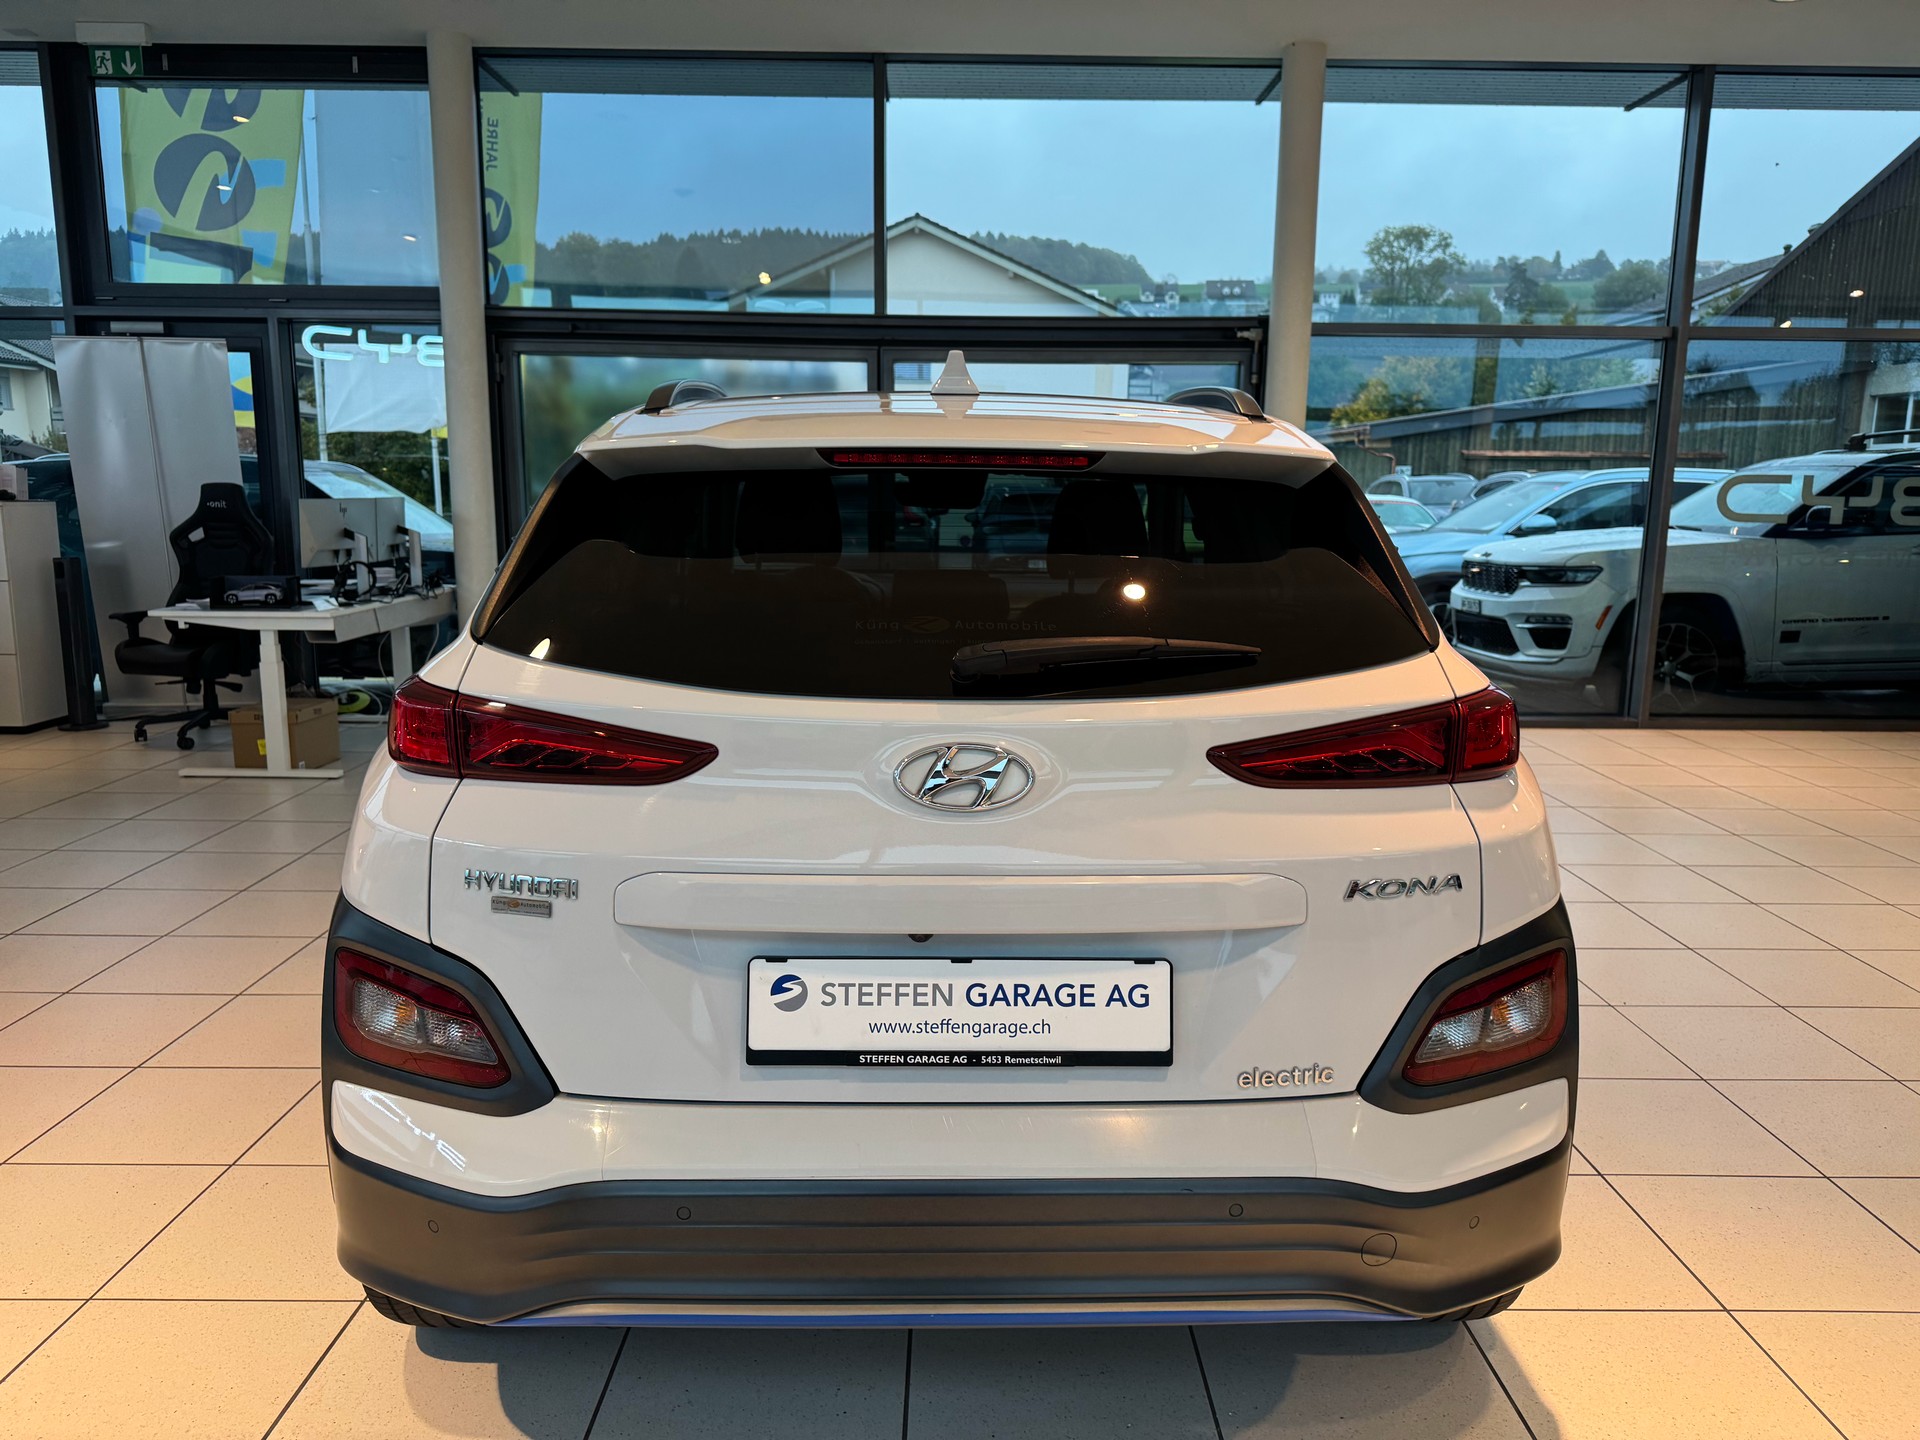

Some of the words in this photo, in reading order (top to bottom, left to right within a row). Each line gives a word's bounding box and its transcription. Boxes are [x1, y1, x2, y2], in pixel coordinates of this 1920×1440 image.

[954, 619, 1058, 632] Automobile
[464, 868, 579, 900] HYUNDAI
[1343, 873, 1463, 901] KONA
[820, 982, 953, 1007] STEFFEN
[965, 982, 1096, 1008] GARAGE
[1104, 983, 1150, 1008] AG
[868, 1018, 1051, 1038] www.steffengarage.ch
[859, 1055, 904, 1064] STEFFEN
[906, 1055, 950, 1064] GARAGE
[952, 1055, 968, 1064] AG
[980, 1055, 1002, 1064] 5453
[1004, 1055, 1062, 1064] Remetschwil
[1237, 1062, 1334, 1088] electric
